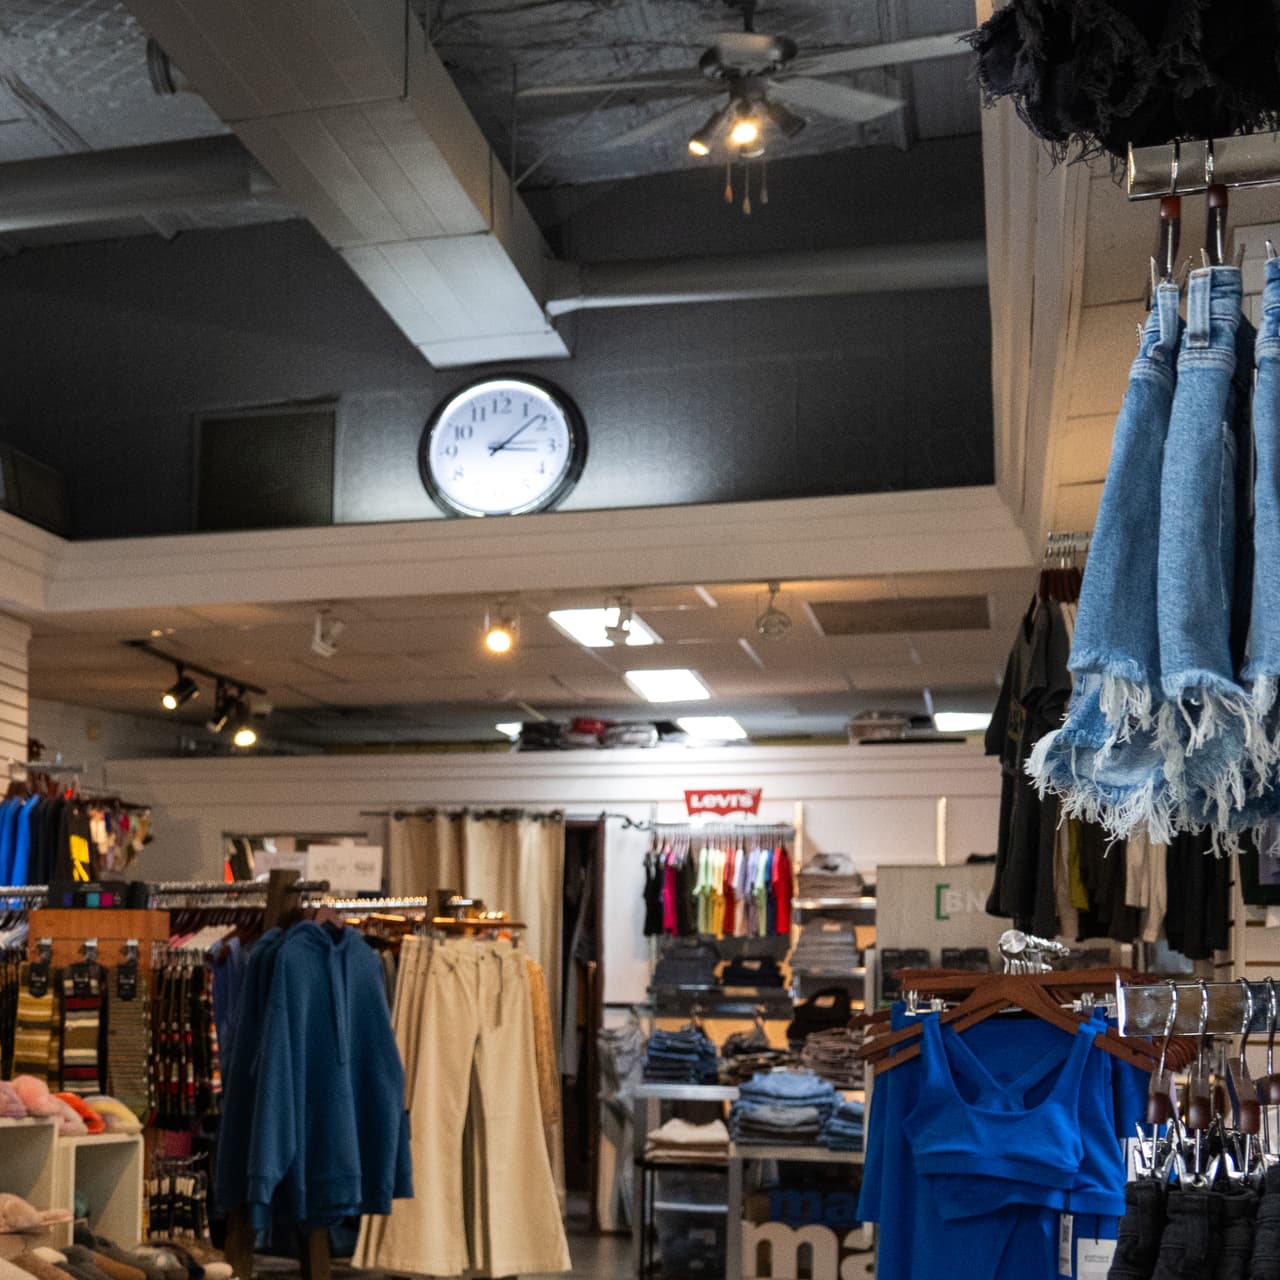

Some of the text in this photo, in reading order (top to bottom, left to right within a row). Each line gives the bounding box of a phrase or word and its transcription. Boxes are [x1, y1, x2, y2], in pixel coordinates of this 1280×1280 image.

[493, 397, 511, 414] 12
[523, 402, 528, 417] 1
[472, 406, 486, 422] 11
[454, 425, 473, 440] 10
